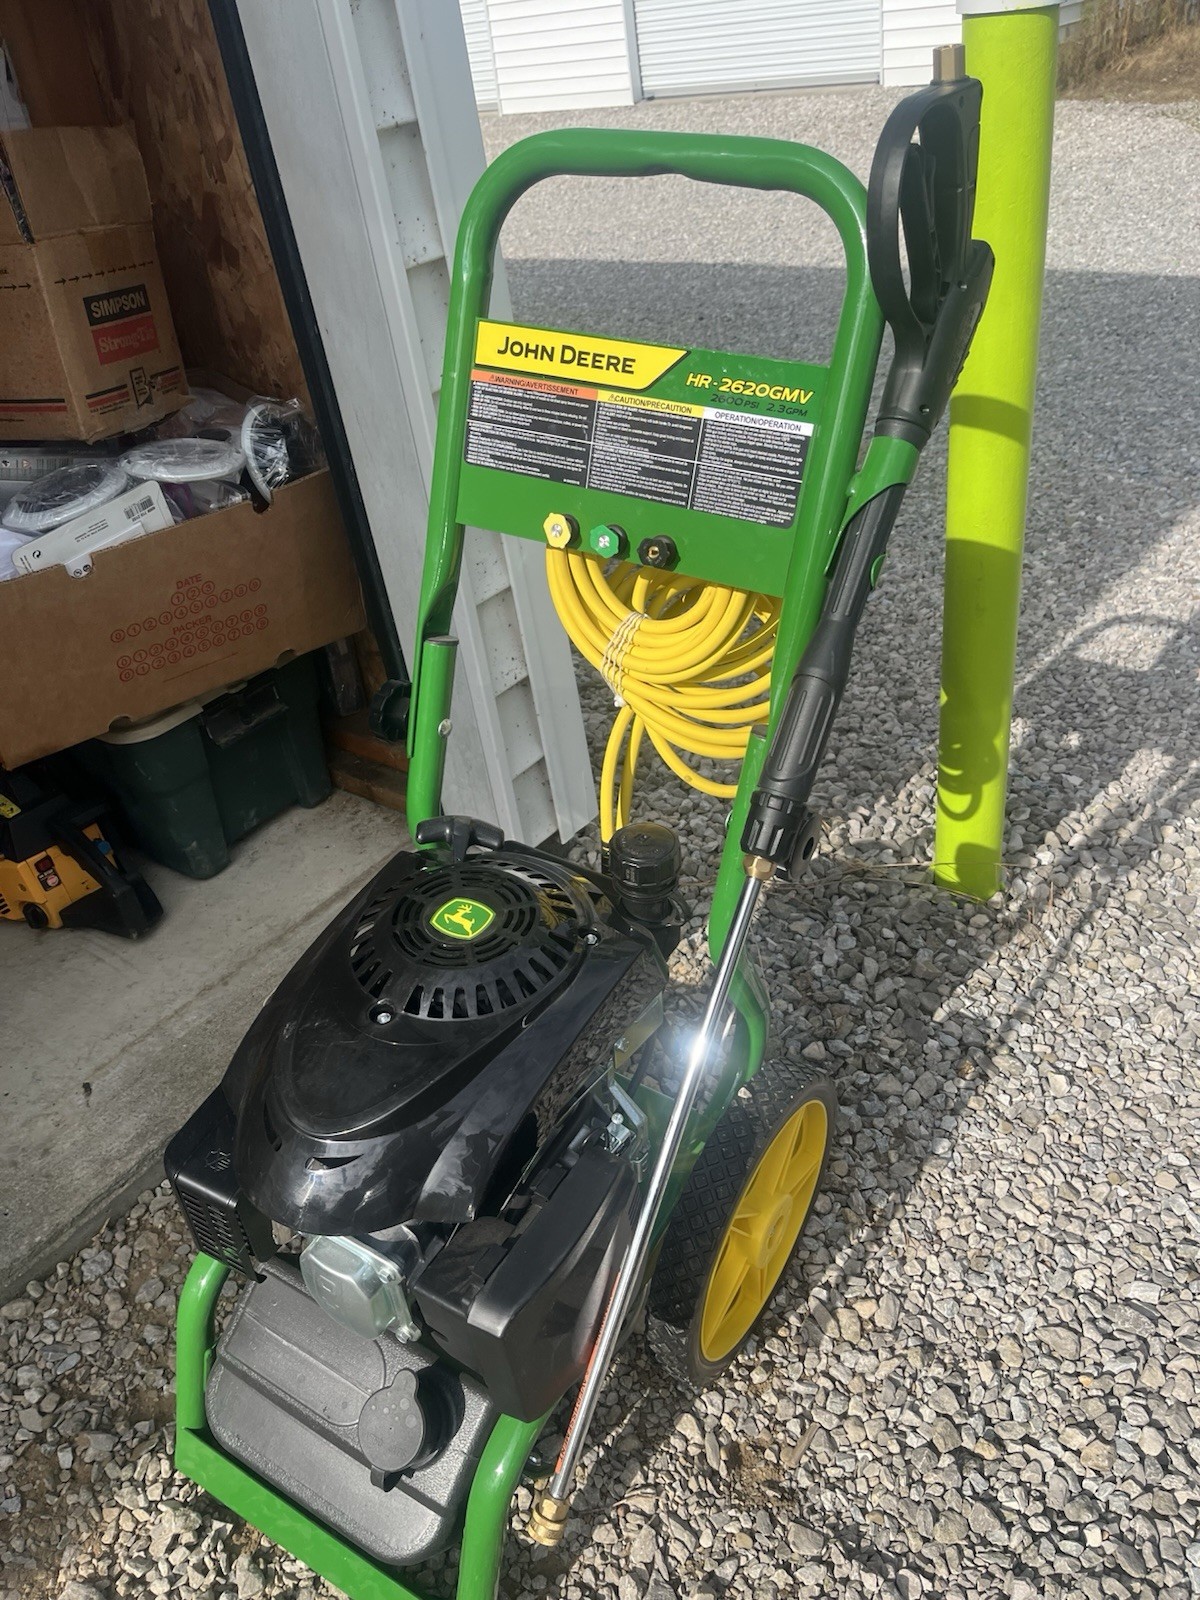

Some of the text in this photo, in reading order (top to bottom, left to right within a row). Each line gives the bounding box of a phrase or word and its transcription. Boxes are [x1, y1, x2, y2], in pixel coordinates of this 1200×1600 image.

[90, 290, 147, 318] SIMPSON
[497, 336, 636, 375] JOHN DEERE
[494, 375, 579, 396] WARNING/AVERTISSEMENT
[176, 573, 202, 589] DATE
[172, 614, 213, 635] PACKER
